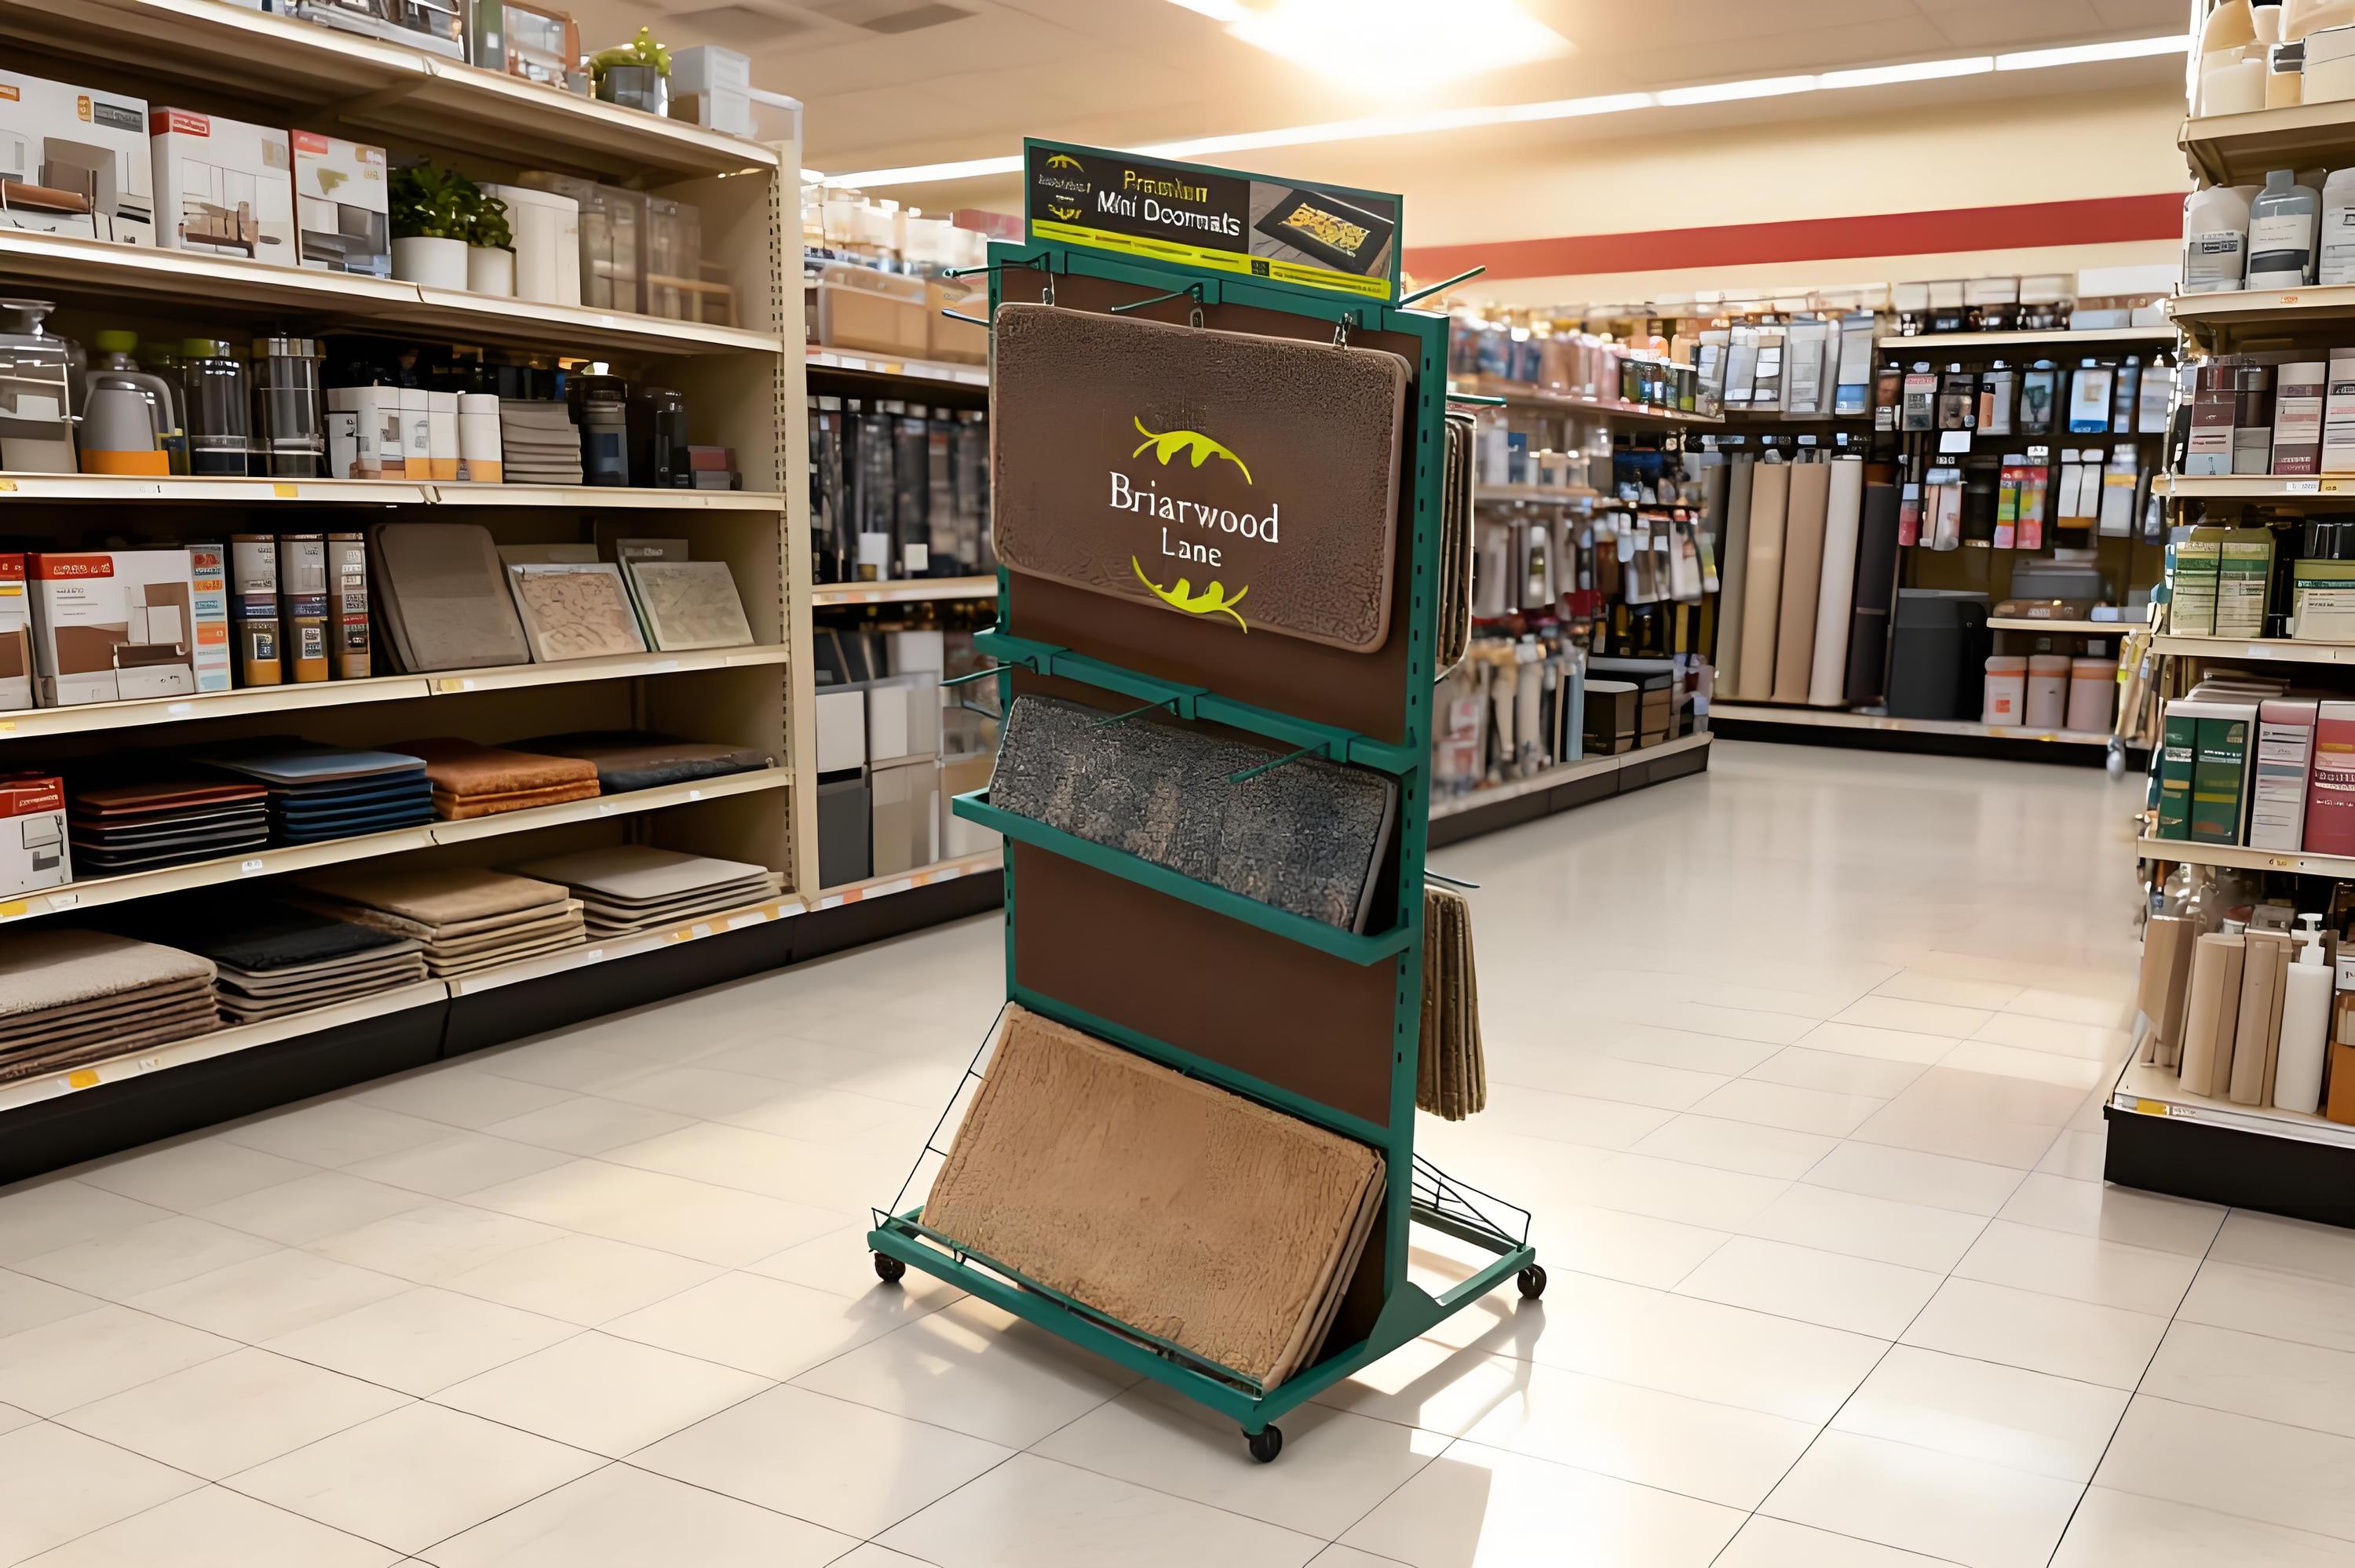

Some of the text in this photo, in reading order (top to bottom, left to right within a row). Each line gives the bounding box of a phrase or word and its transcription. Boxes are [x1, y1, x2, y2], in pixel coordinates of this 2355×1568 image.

[1097, 191, 1137, 217] Mini
[1109, 471, 1278, 543] Briarwood
[1162, 527, 1221, 567] Lane
